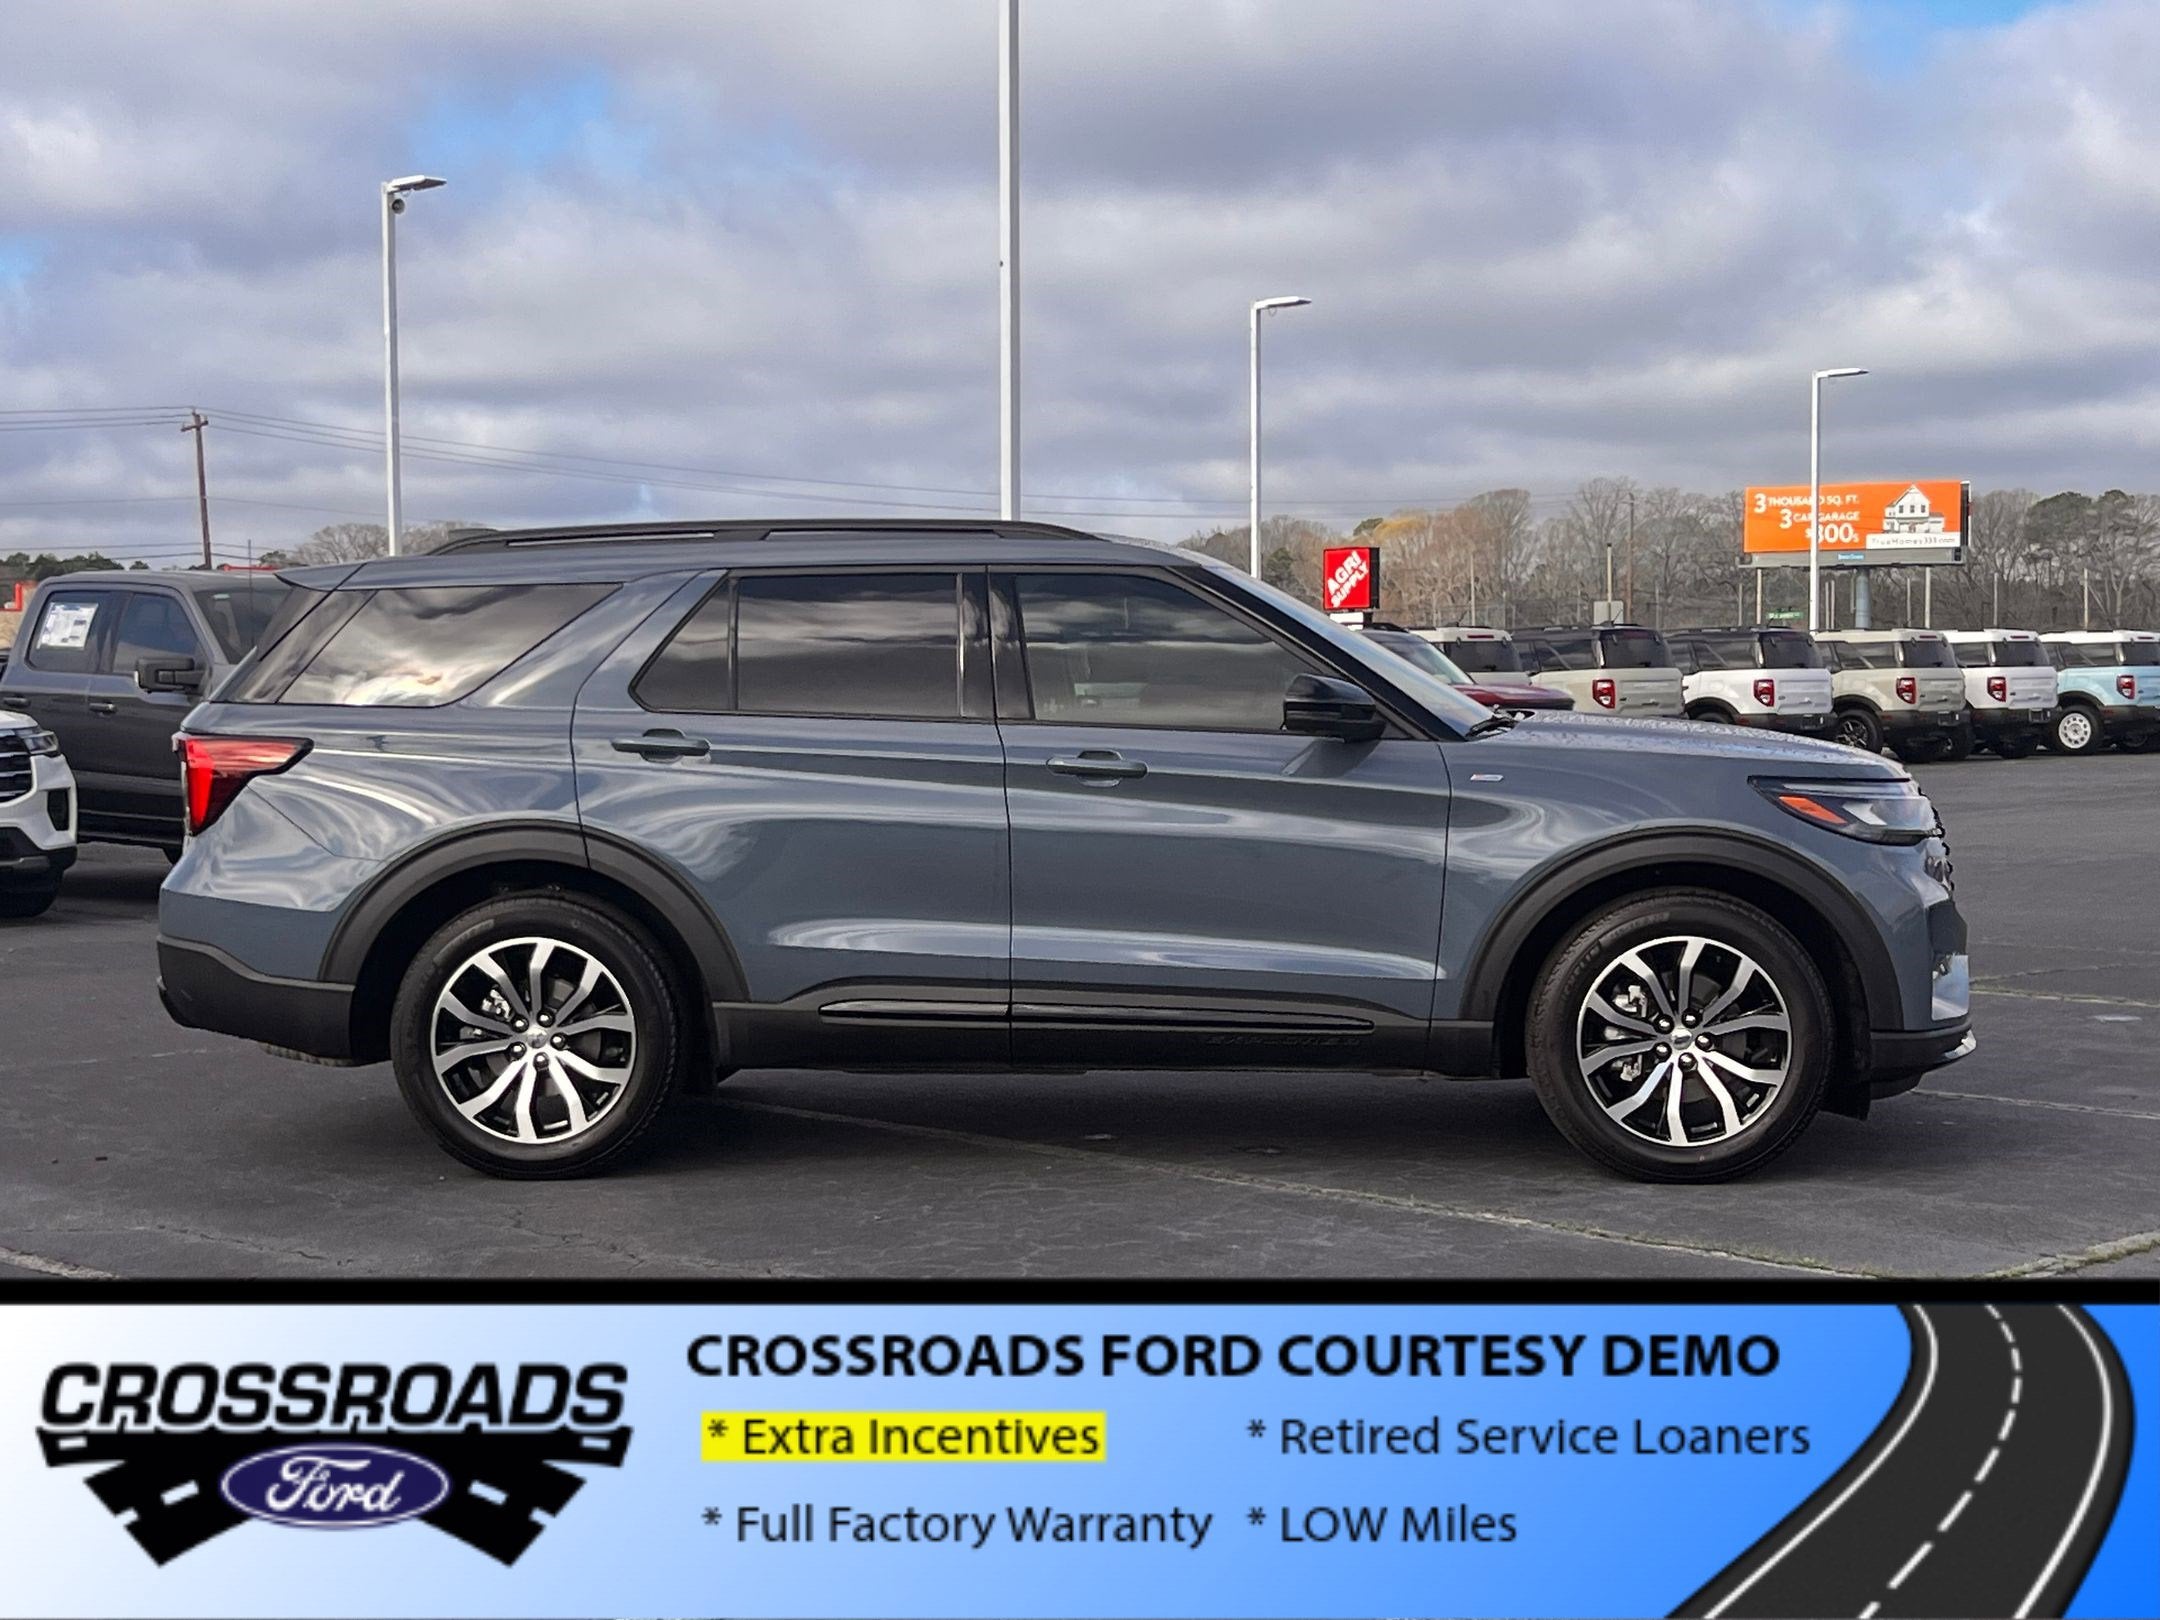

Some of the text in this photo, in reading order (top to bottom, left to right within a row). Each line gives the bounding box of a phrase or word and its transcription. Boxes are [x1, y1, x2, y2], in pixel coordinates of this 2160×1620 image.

[1753, 493, 1767, 513] 3
[1768, 495, 1825, 507] THOUSAD
[1779, 508, 1792, 529] 3
[1818, 511, 1860, 523] GARAGE
[1327, 550, 1362, 596] AGRI
[1330, 560, 1368, 608] SUPPLY
